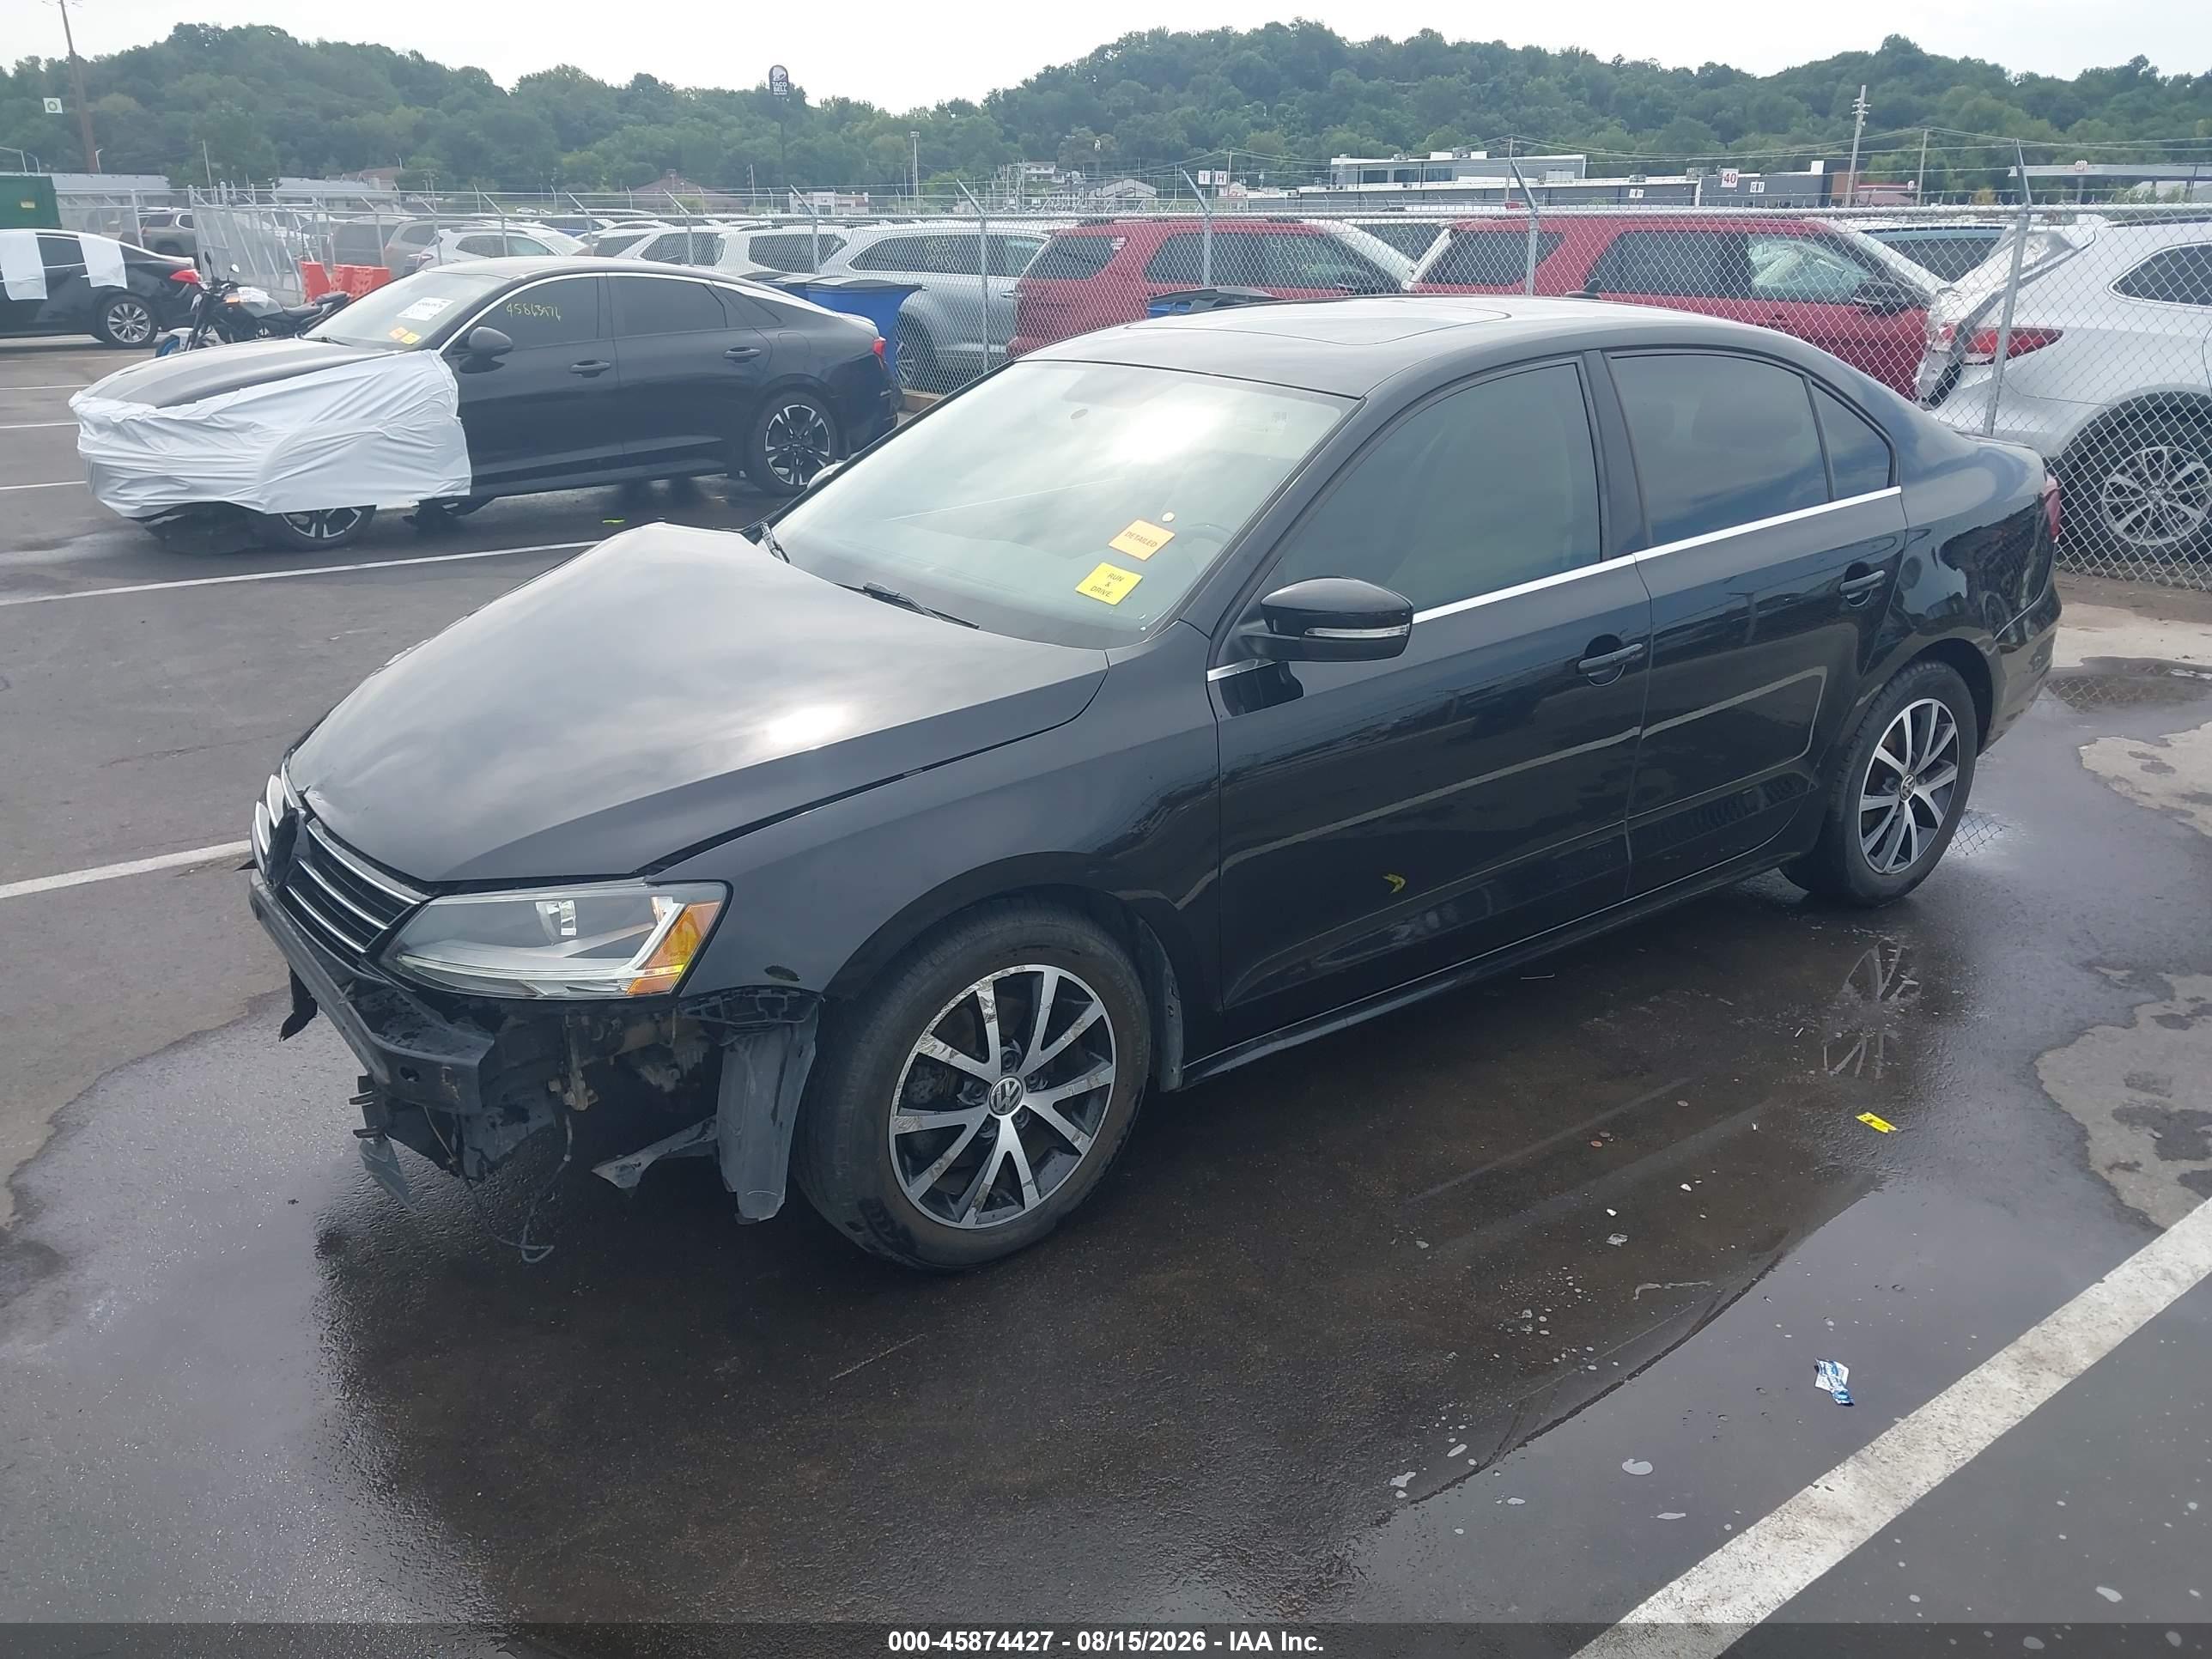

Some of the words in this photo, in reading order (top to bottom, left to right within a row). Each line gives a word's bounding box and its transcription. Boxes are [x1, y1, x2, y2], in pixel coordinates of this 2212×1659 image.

[1723, 173, 1737, 184] 40
[1124, 530, 1158, 548] DETAILED
[1106, 572, 1125, 582] RUN
[1090, 585, 1113, 598] DRIVE
